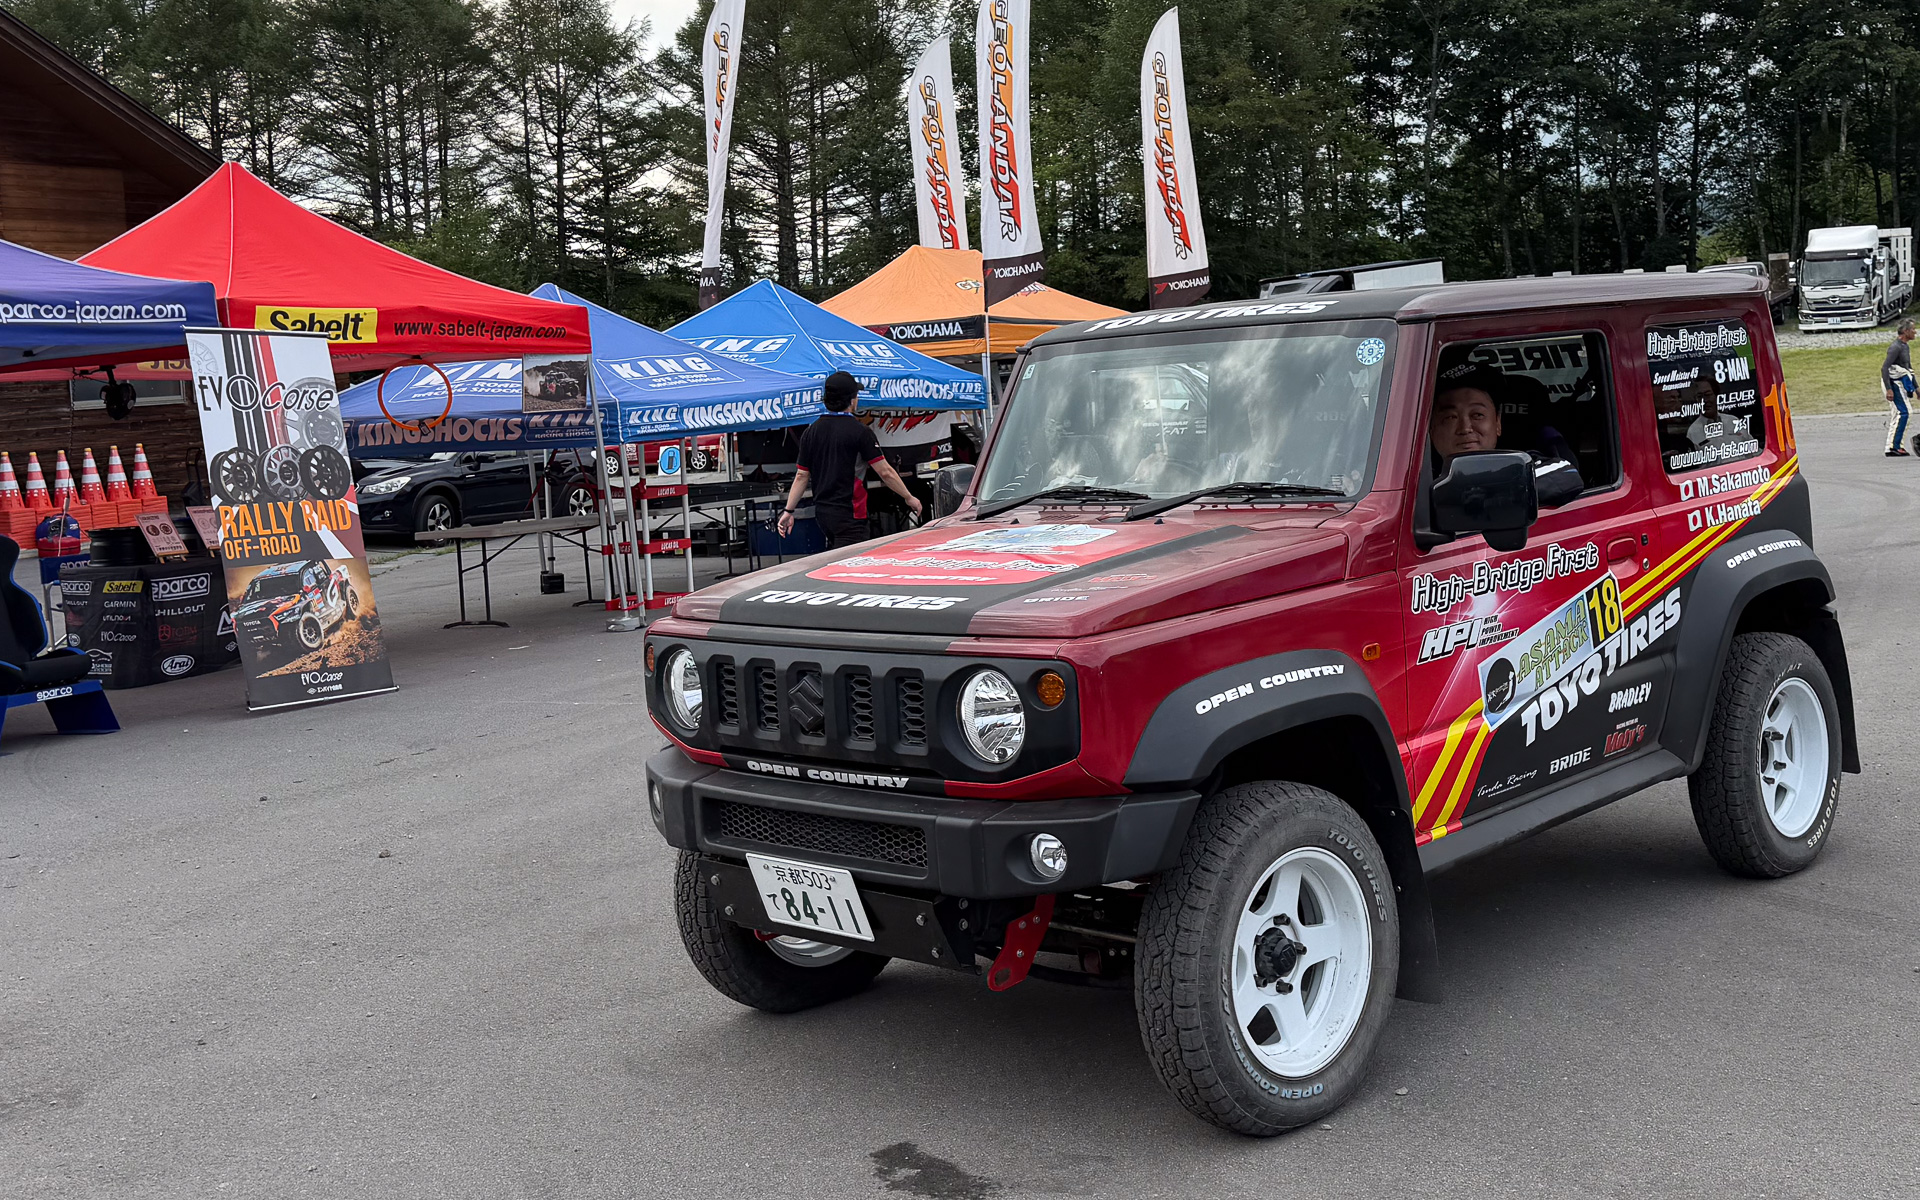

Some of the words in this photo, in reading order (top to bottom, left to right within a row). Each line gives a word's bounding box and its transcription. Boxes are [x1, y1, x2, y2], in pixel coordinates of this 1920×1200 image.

[923, 75, 958, 249] GEOLANDA
[1153, 51, 1193, 261] GEOLANDAR
[993, 261, 1044, 280] YOKOHAMA
[0, 301, 187, 323] parco-japan.com
[1083, 310, 1201, 333] TOYO
[1195, 300, 1340, 320] TIRES
[394, 317, 567, 340] www.sabelt-japan.com
[889, 322, 963, 340] YOKOHAMA
[1647, 328, 1717, 359] High-Bridge
[1717, 325, 1748, 348] First
[821, 341, 894, 358] KING
[413, 361, 523, 387] KIN
[609, 356, 714, 379] KING
[1690, 366, 1700, 379] 45
[628, 406, 678, 424] KING
[682, 398, 783, 430] KINGSHOCKS
[783, 388, 823, 407] KING
[1681, 397, 1706, 418] smart
[1716, 389, 1755, 405] CLEVER
[358, 417, 522, 447] KINGSHOCKS
[1670, 439, 1759, 470] www.hb-1st.com
[1696, 465, 1771, 498] M.Sakamoto
[219, 501, 294, 539] RALLY
[302, 499, 352, 533] RAID
[1704, 495, 1761, 528] K.Hanata
[224, 534, 301, 560] OFF-ROAD
[1726, 552, 1756, 570] OPEN
[1757, 539, 1802, 559] COUNTRY
[106, 581, 137, 592] Sabelt
[1411, 560, 1545, 615] High-Bridge
[1546, 543, 1599, 579] First
[104, 600, 136, 608] GARMIN
[746, 589, 843, 607] TOYO
[843, 593, 969, 610] TIRES
[1023, 595, 1090, 604] BRIDE
[1588, 577, 1620, 641] 18
[1483, 614, 1499, 625] HIGH
[1603, 587, 1682, 676] TIRES
[1417, 618, 1483, 665] HPI
[1516, 598, 1587, 684] ASAMA
[1534, 623, 1588, 691] ATTACK
[37, 685, 73, 702] sparco
[1195, 683, 1254, 715] OPEN
[1259, 664, 1345, 689] COUNTRY
[1521, 651, 1601, 748] TOYO
[1608, 681, 1652, 713] BRADLEY
[747, 760, 800, 777] OPEN
[807, 769, 910, 789] COUNTRY
[1549, 746, 1591, 775] BRIDE
[1507, 769, 1538, 785] Racing
[1807, 817, 1828, 849] TIRES
[772, 864, 832, 891] 京都503
[1327, 828, 1362, 864] TOYO
[1361, 862, 1389, 922] TIRES
[780, 886, 863, 935] 84-11
[1226, 1022, 1280, 1096] COUNTRY
[1280, 1082, 1325, 1100] OPEN
